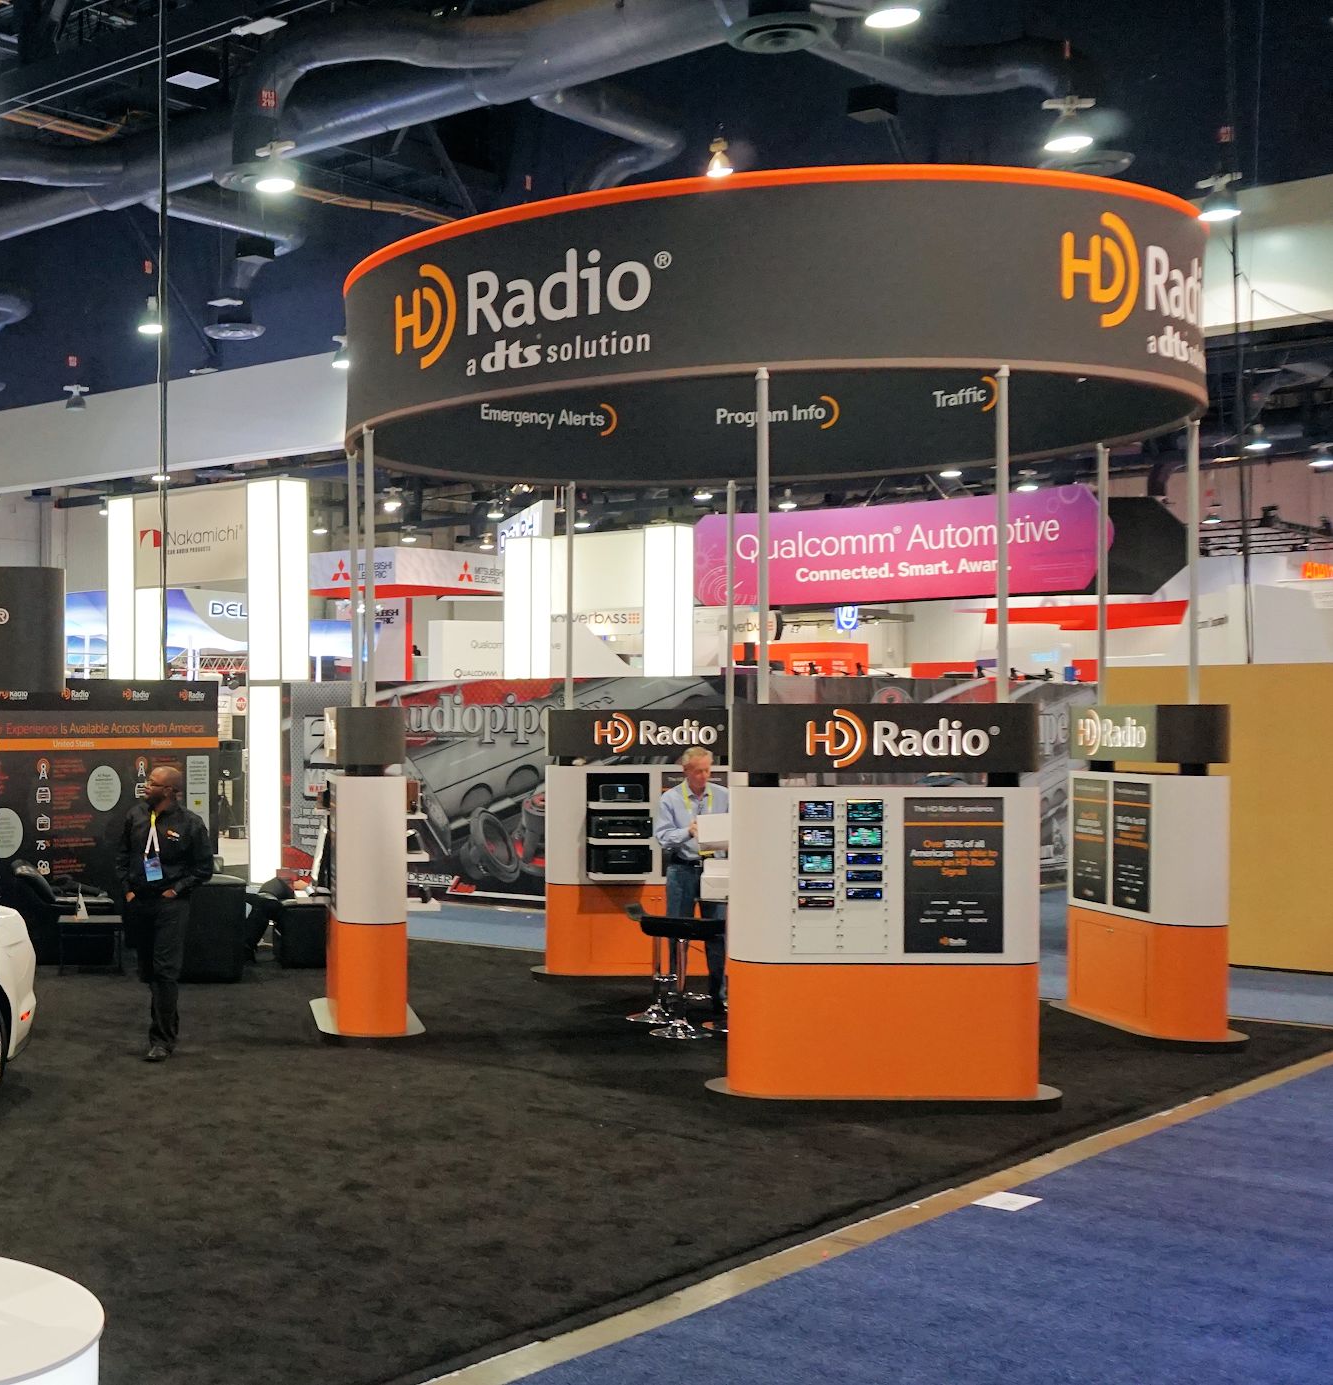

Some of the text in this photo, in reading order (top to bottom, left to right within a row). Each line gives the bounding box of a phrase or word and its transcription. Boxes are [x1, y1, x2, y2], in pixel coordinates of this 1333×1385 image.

[1061, 212, 1203, 328] HD Radi
[395, 264, 457, 369] HD
[467, 330, 651, 377] a dts solution
[1147, 335, 1157, 354] a
[932, 387, 987, 409] Traffic
[480, 402, 826, 430] Emergency Alerts Progam Info
[167, 525, 239, 546] Nakamichi
[475, 566, 504, 576] MITSUBISH
[796, 557, 1011, 583] Connected. Smart. Awar.
[211, 602, 248, 617] DEL
[6, 723, 57, 735] Experience
[60, 723, 68, 733] Is
[69, 722, 109, 733] Available
[111, 723, 139, 733] Across
[142, 722, 166, 733] North
[594, 712, 636, 754] HD
[806, 708, 867, 768] HD
[1101, 716, 1146, 748] Radio
[53, 740, 75, 748] United
[151, 738, 172, 747] Mexico
[910, 849, 954, 857] Americans
[922, 840, 943, 848] Over
